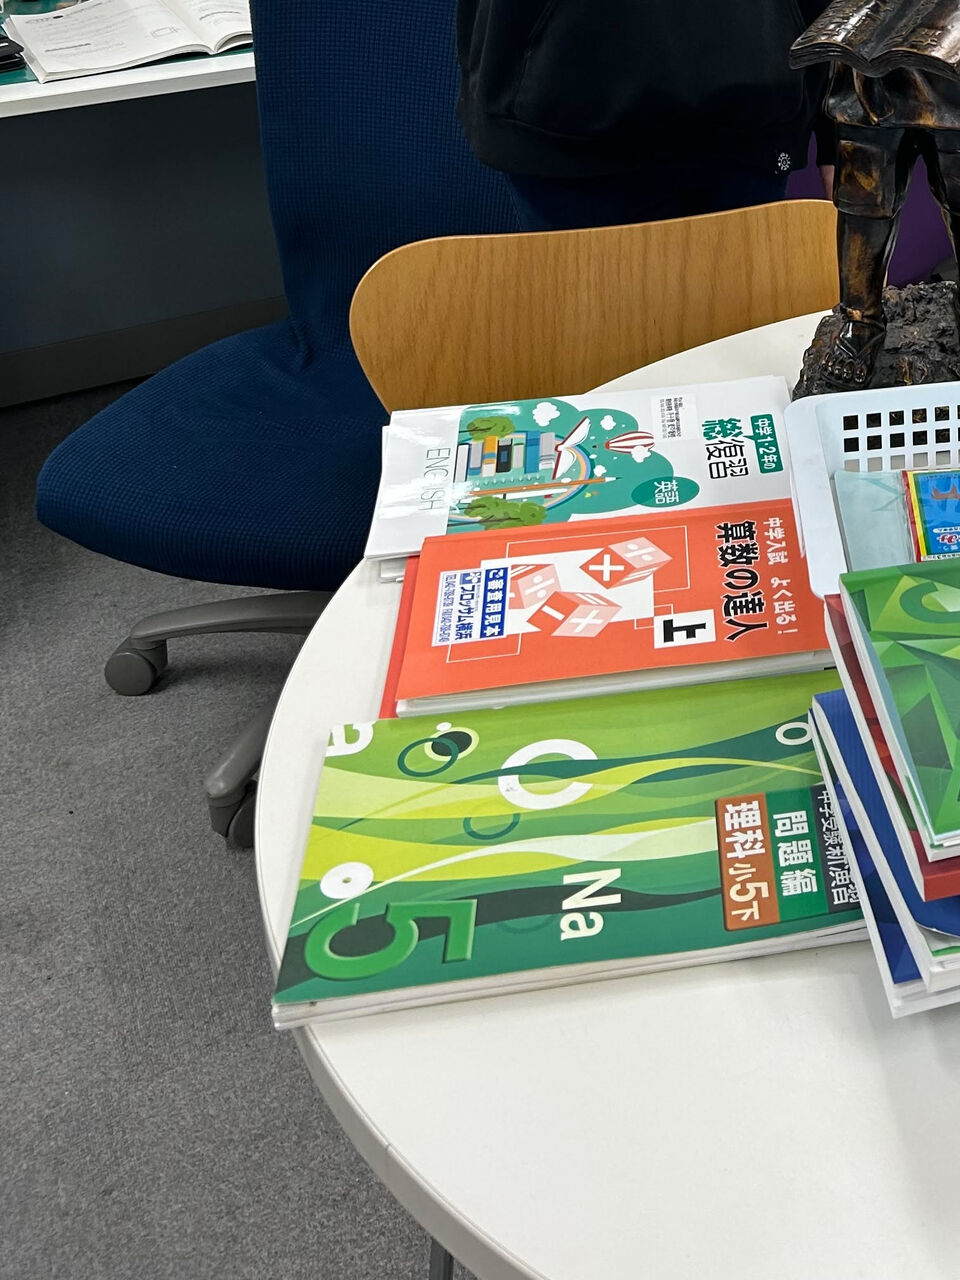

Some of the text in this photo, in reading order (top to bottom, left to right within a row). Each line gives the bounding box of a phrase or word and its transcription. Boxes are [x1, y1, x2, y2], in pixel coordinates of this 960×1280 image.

[421, 446, 451, 511] ENGISH
[702, 418, 749, 479] 総復習
[653, 478, 681, 504] 英語
[763, 517, 788, 566] 中学入試
[483, 569, 504, 638] ご審査用見本
[716, 520, 768, 641] 算数の達人
[663, 618, 706, 643] 上
[724, 800, 769, 922] 理科小5下
[773, 810, 818, 897] 問題編
[559, 867, 622, 942] Na
[304, 899, 478, 981] 5
